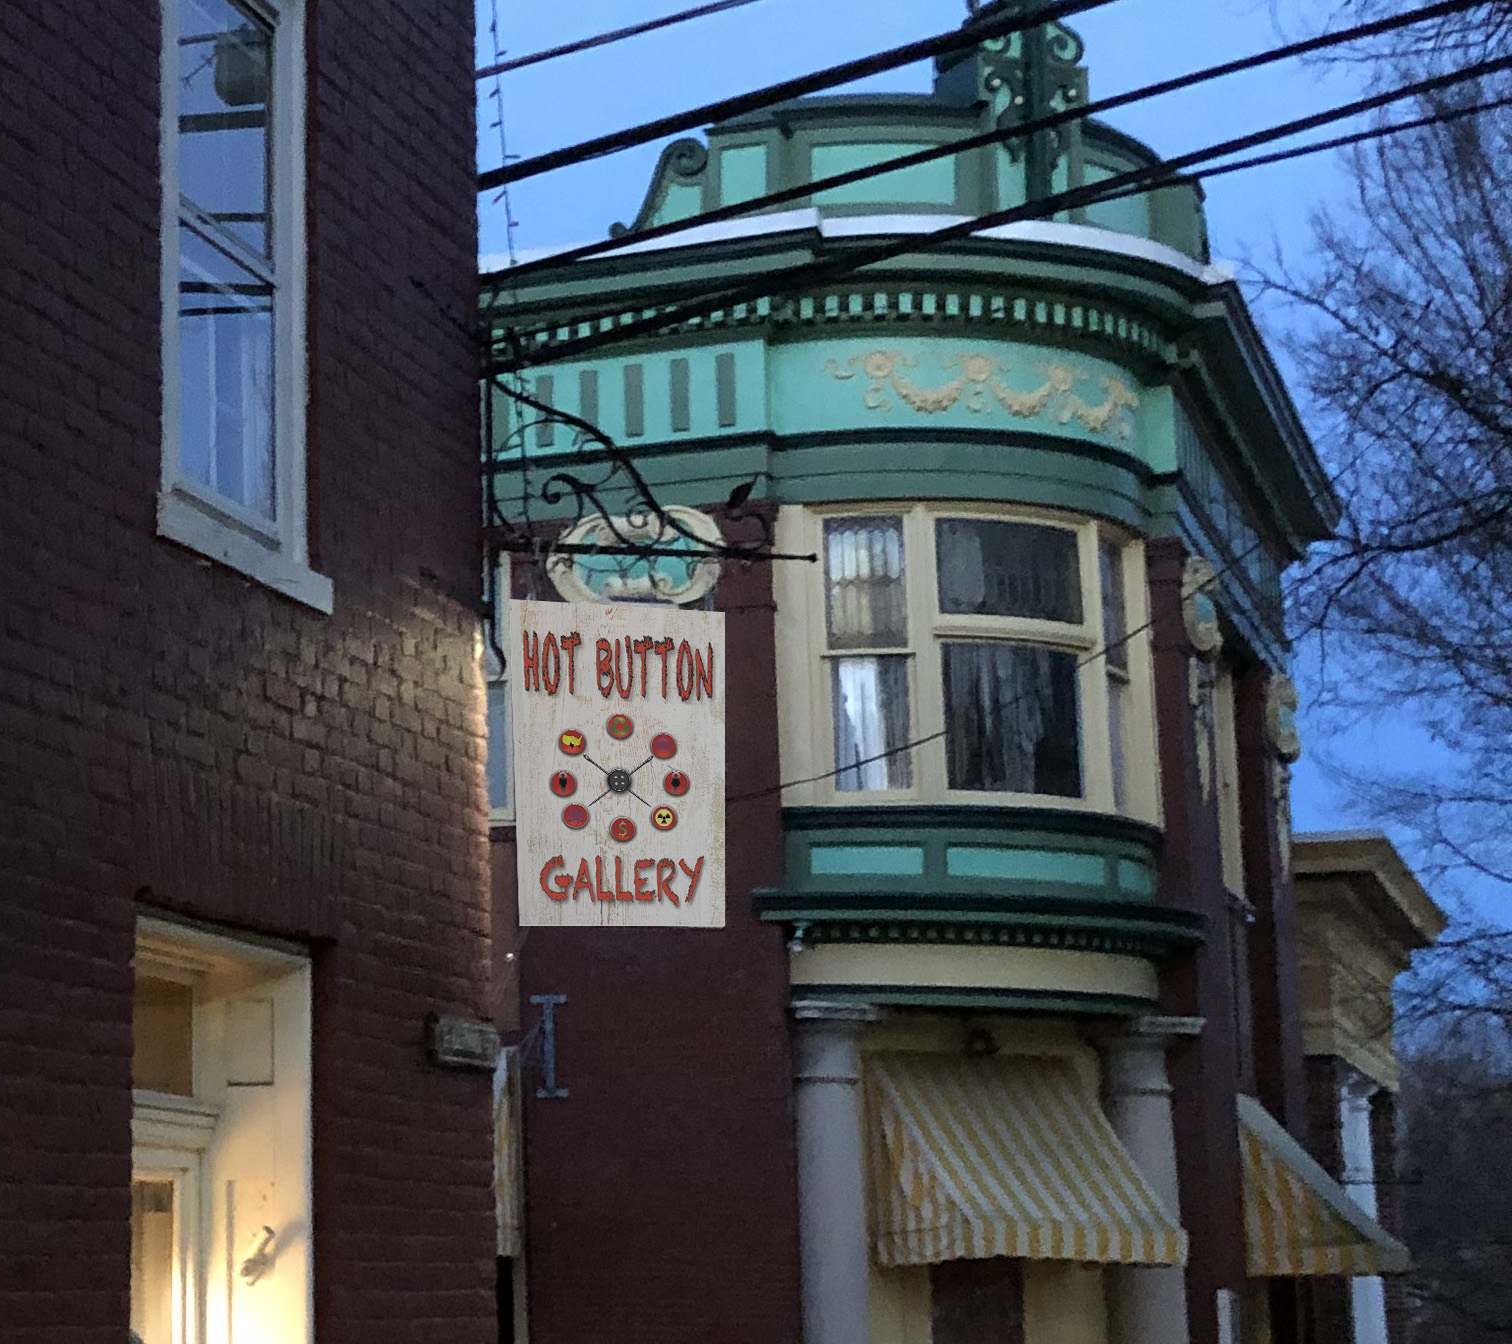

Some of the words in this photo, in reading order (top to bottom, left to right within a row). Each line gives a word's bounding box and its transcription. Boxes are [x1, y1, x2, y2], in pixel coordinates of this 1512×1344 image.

[522, 630, 581, 696] HOT
[595, 634, 714, 701] BUTTON
[539, 855, 705, 907] GALLERY
